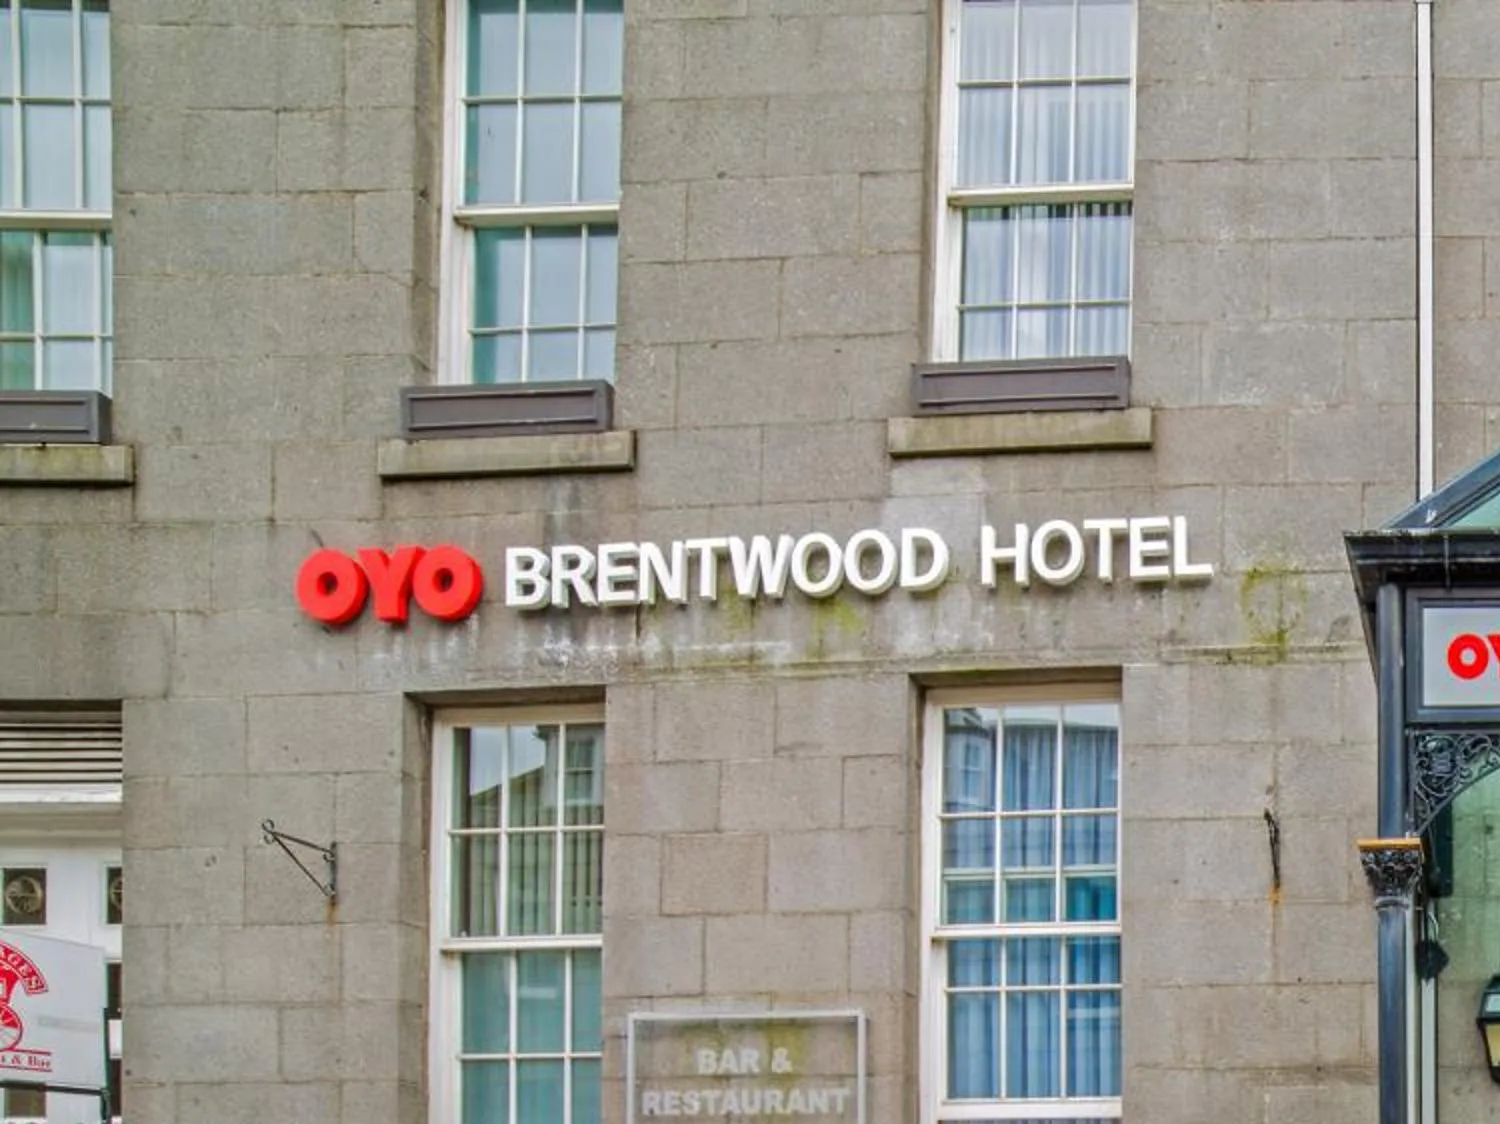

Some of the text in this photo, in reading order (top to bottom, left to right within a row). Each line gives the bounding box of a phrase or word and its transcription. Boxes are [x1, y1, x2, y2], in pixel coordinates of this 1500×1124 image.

[296, 516, 1214, 625] OYO BRENTWOOD HOTEL
[697, 1047, 793, 1074] BAR &
[641, 1087, 850, 1117] RESTAURANT
